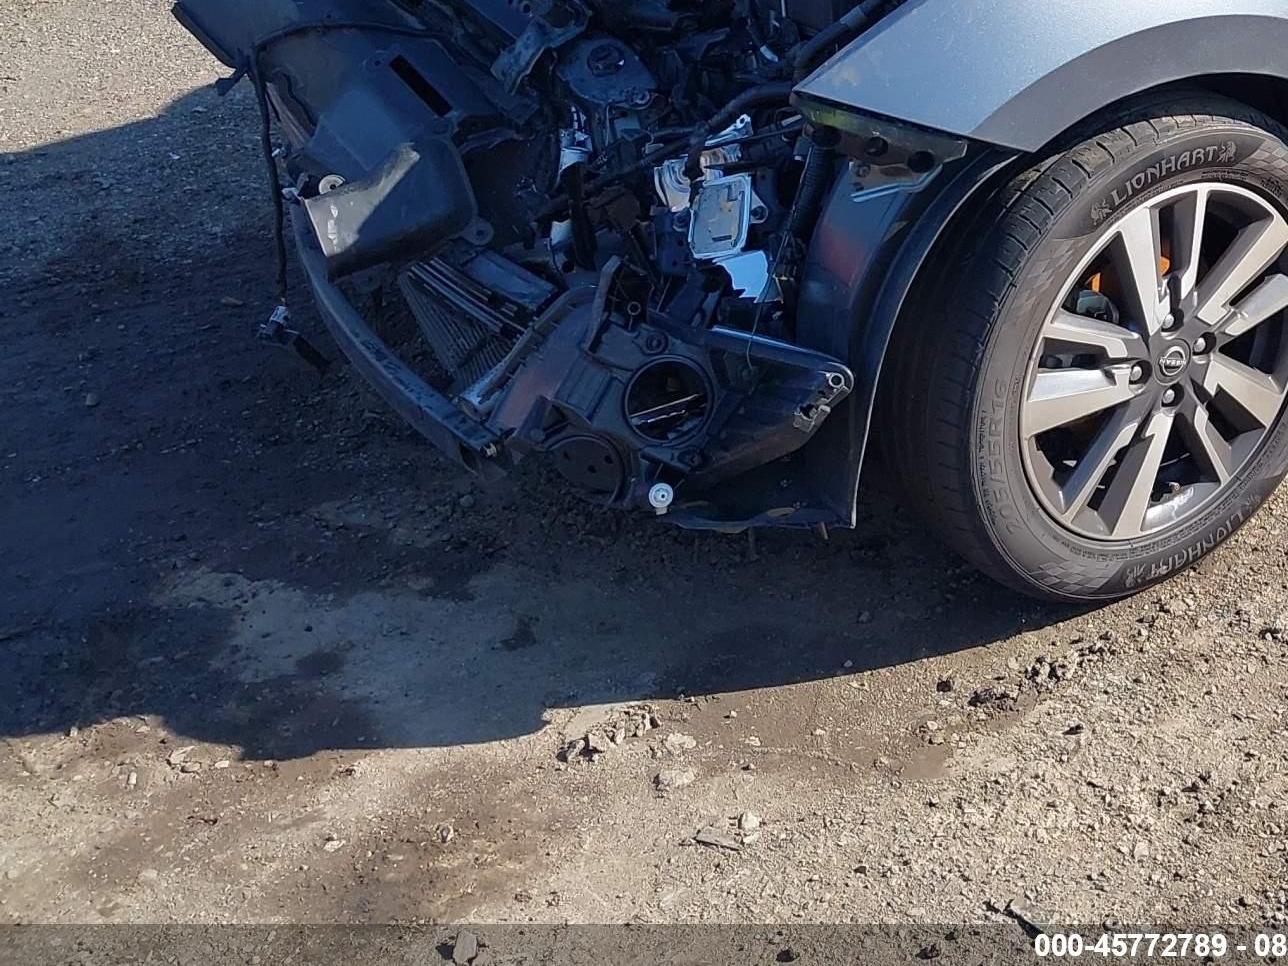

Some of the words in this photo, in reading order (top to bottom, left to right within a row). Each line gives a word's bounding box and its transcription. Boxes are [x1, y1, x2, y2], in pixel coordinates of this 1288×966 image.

[1110, 145, 1218, 206] LIONHART
[988, 376, 1023, 534] 205/55R16
[1146, 511, 1244, 580] LIONHART
